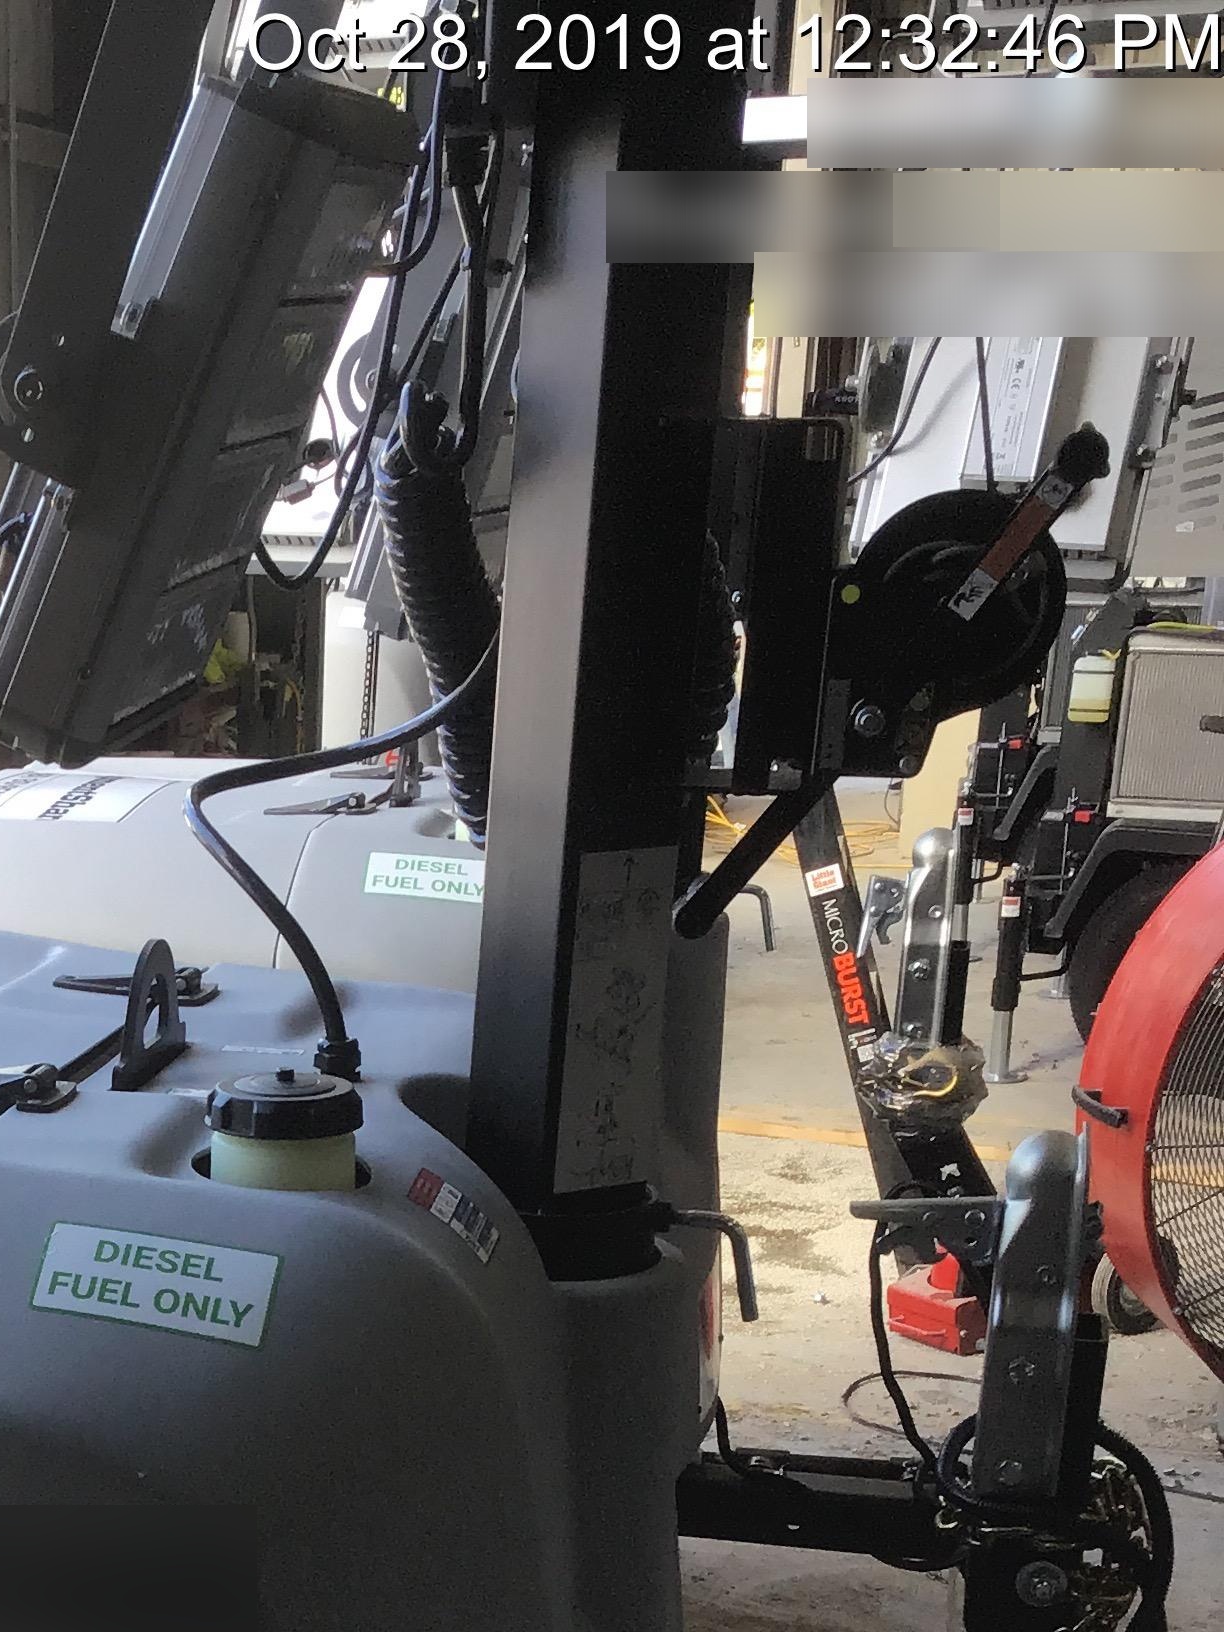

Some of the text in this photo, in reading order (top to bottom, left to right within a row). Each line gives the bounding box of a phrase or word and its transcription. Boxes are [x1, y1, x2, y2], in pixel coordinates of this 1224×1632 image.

[395, 859, 468, 875] DIESEL
[372, 875, 484, 896] FUEL ONLY
[93, 1239, 224, 1283] DIESEL
[47, 1270, 255, 1329] FUEL ONLY
